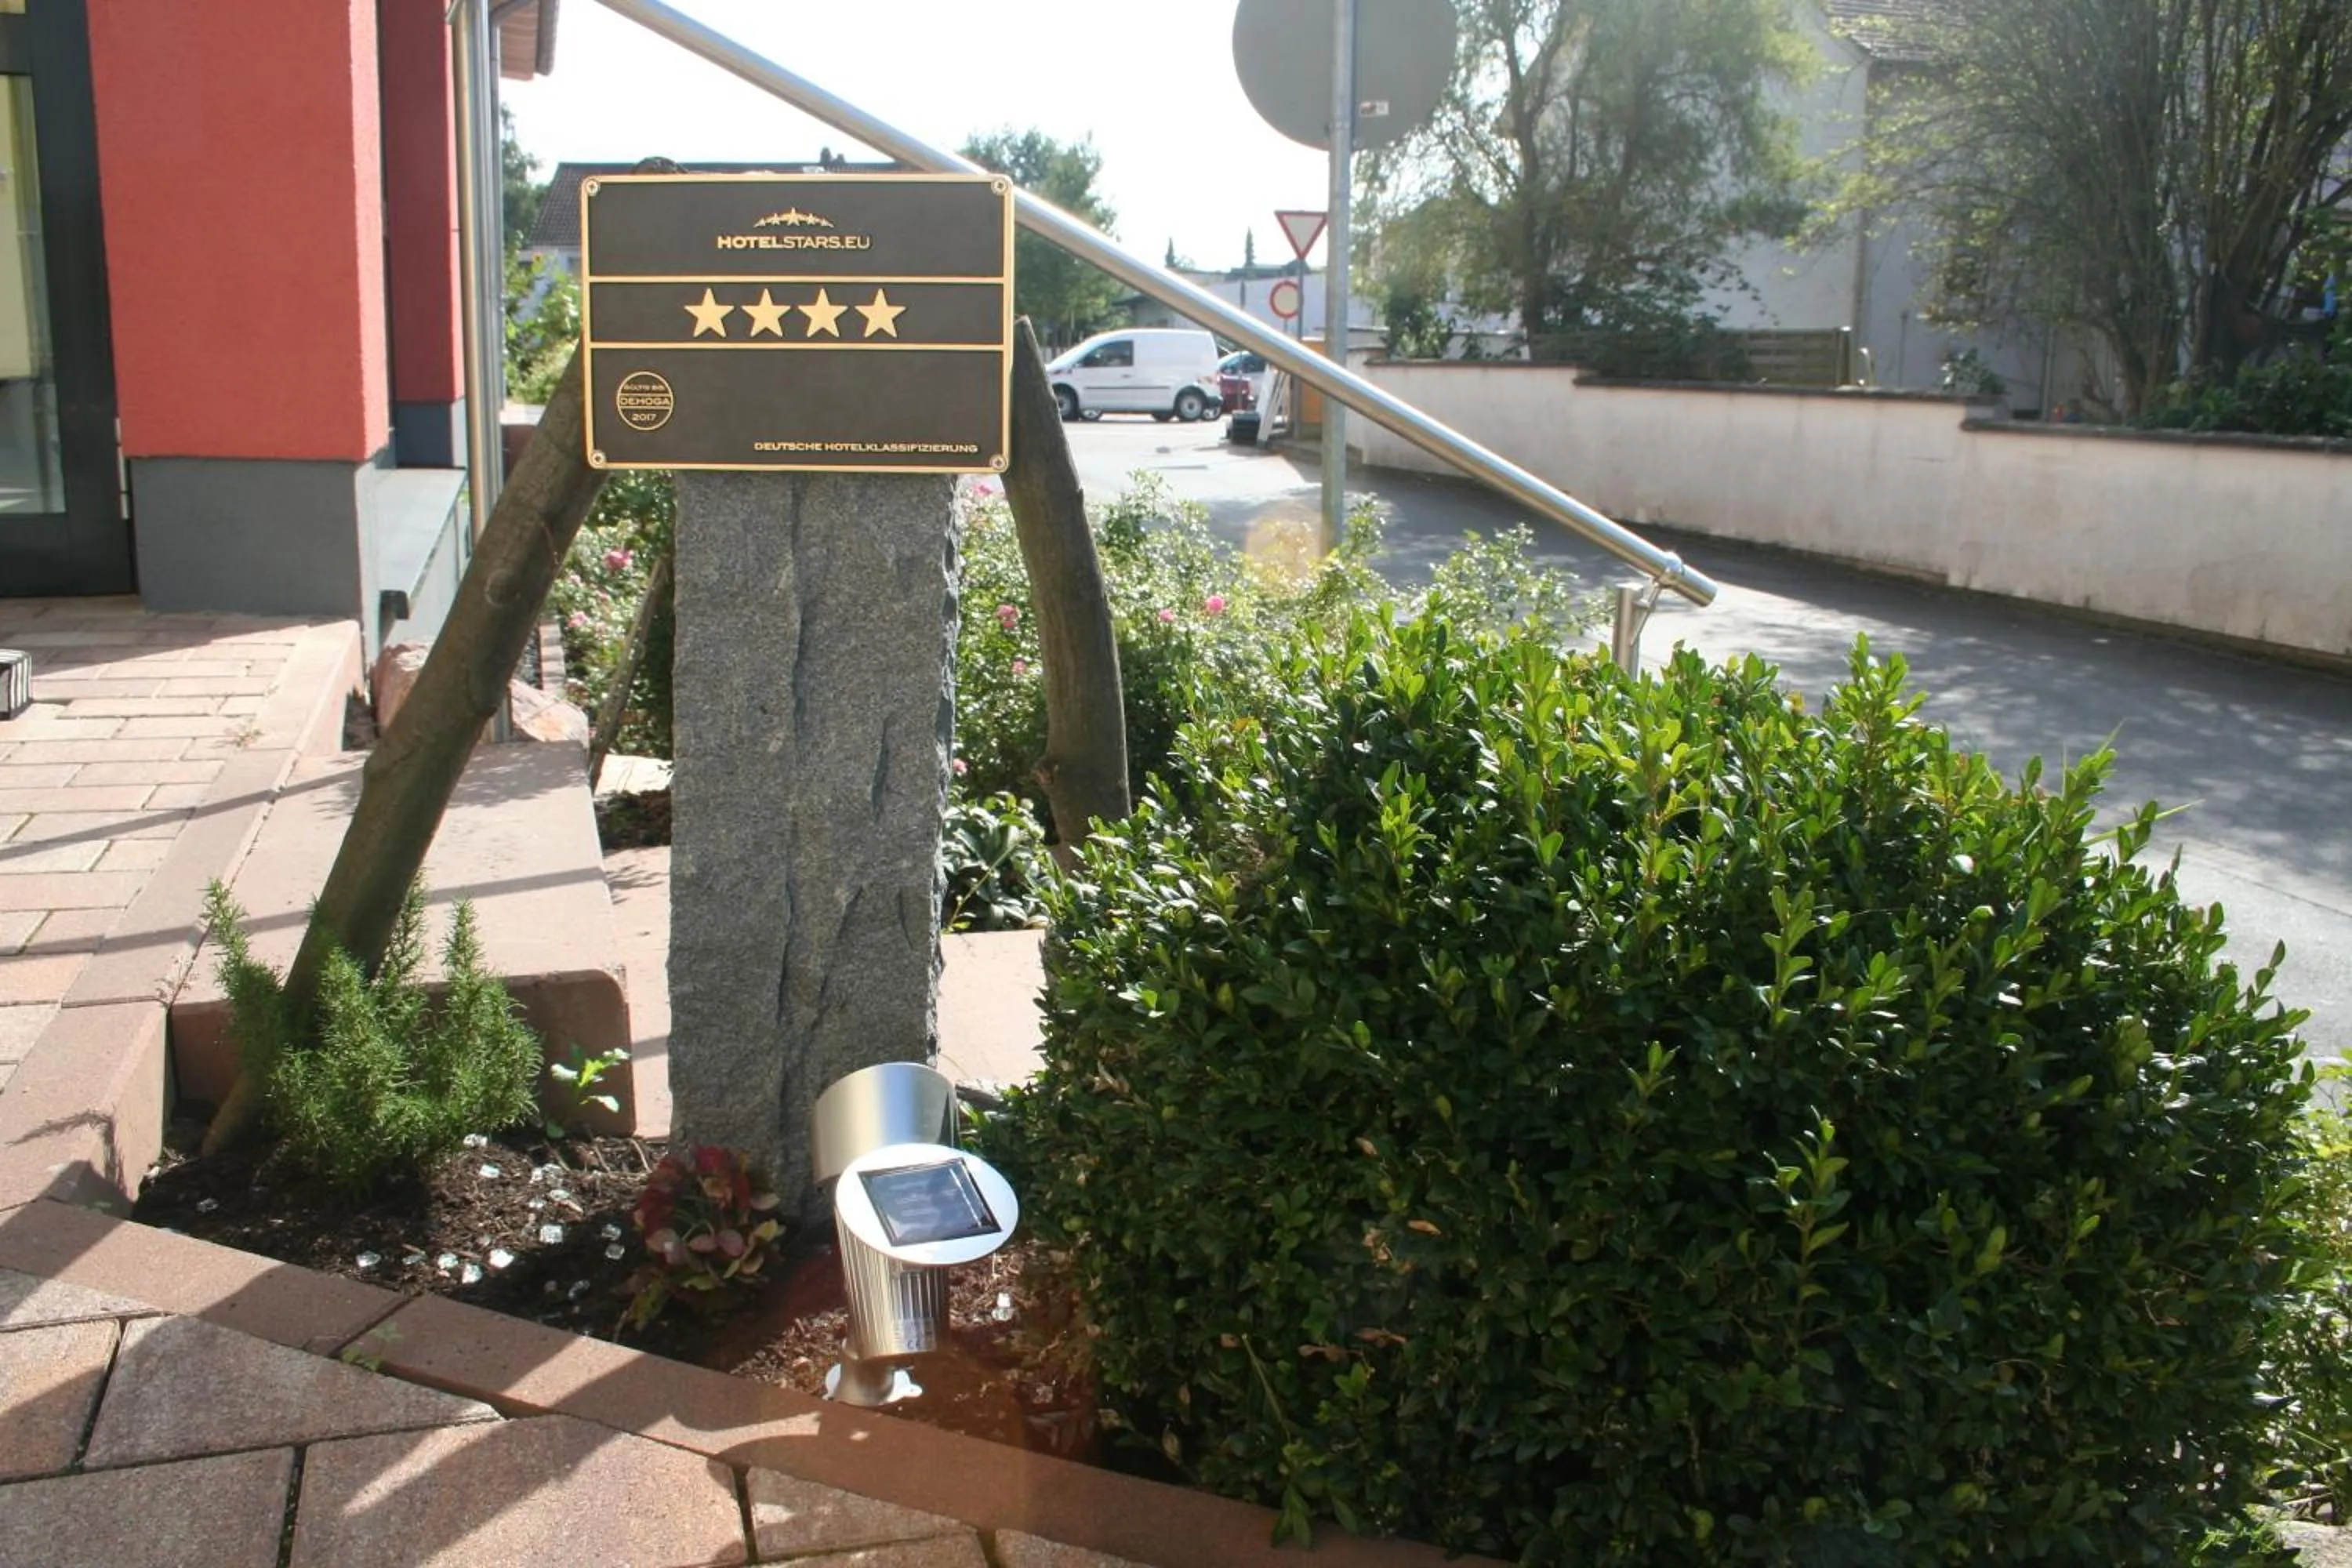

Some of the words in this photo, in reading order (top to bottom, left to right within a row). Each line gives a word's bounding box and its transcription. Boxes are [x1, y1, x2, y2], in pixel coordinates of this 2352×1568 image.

[717, 235, 870, 249] HOTELSTARS.EU
[753, 442, 822, 452] DEUTSCHE
[825, 442, 978, 453] HOTELKLASSIFIZIERUNG
